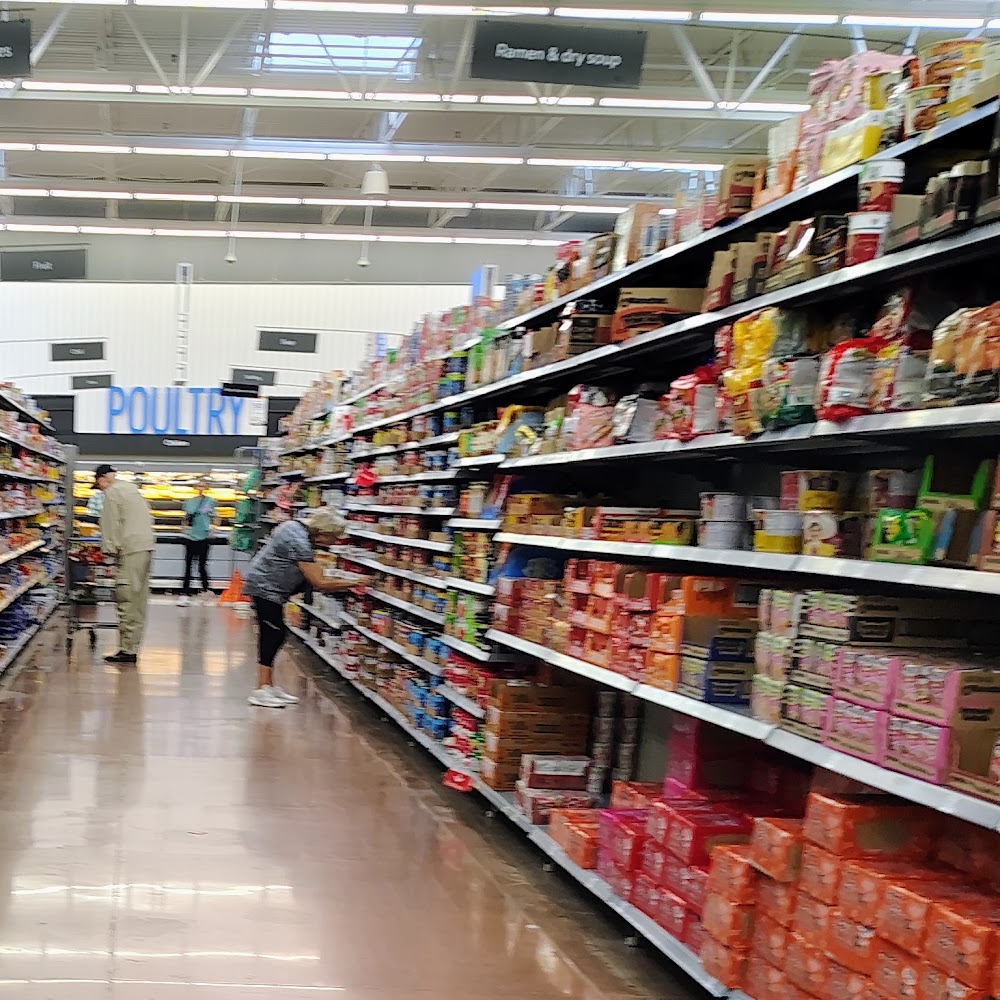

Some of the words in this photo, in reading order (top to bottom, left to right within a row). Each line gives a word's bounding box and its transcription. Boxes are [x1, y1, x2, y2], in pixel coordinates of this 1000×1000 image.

[495, 43, 546, 61] Ramen
[546, 46, 560, 62] &
[560, 48, 587, 67] dry
[586, 53, 623, 69] soup
[107, 386, 245, 435] POULTRY
